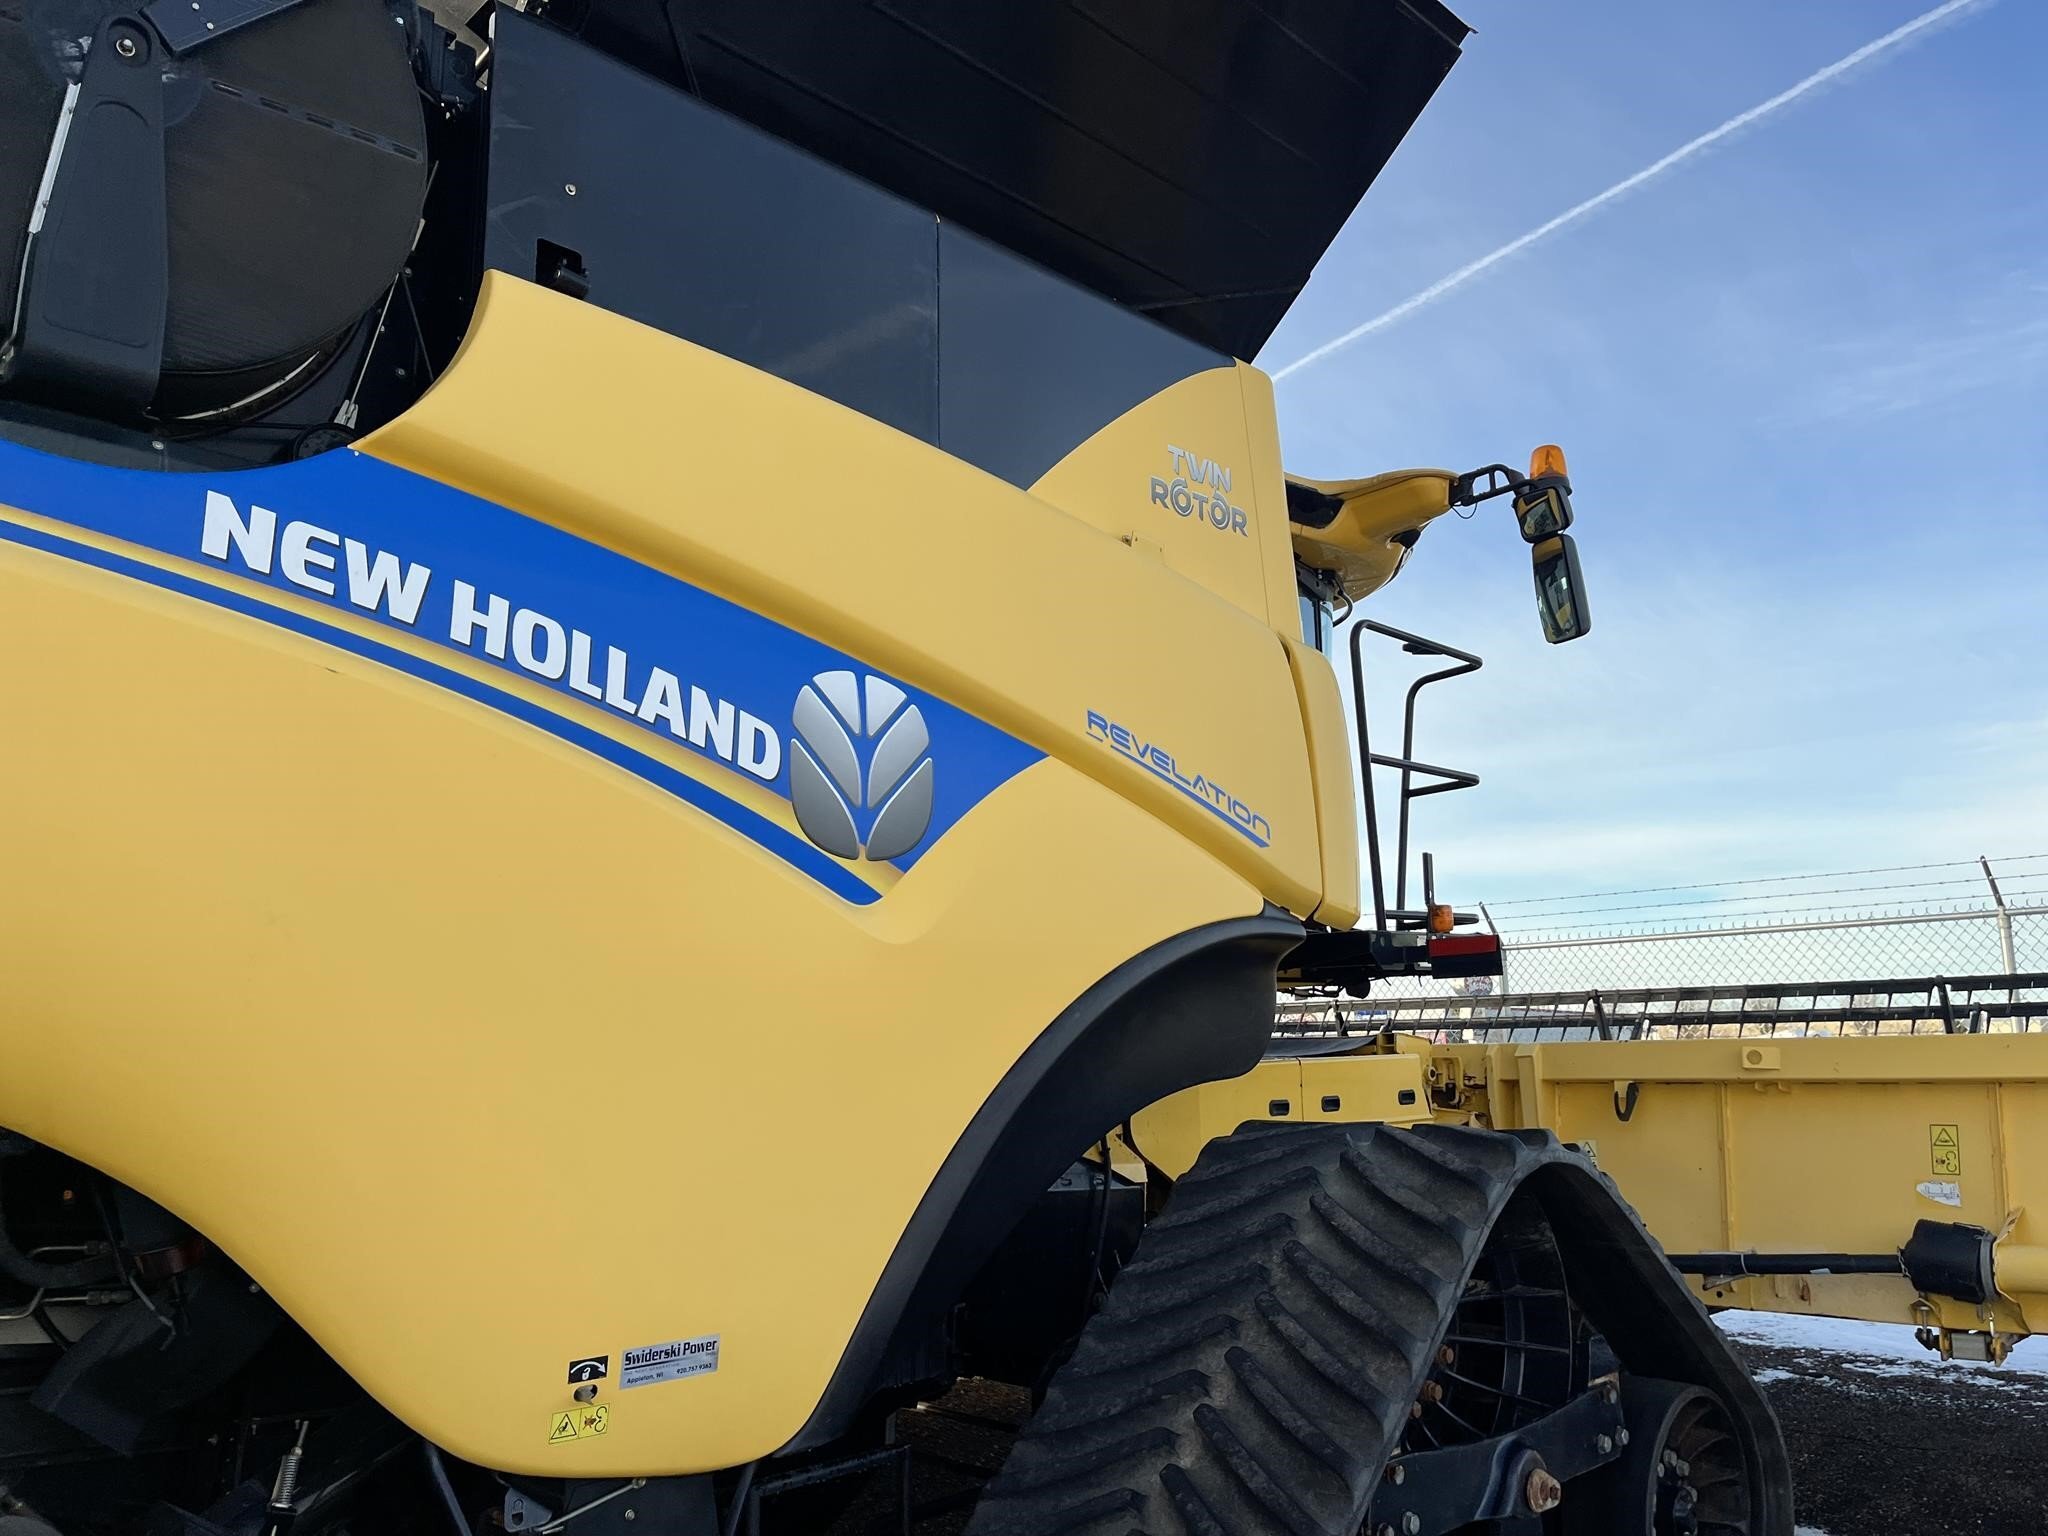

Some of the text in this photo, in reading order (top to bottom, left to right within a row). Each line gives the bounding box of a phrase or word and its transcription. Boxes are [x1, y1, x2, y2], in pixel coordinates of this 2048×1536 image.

[1167, 444, 1232, 493] TWIN
[1150, 476, 1248, 537] ROTOR
[201, 489, 782, 782] NEW HOLLAND
[1087, 709, 1271, 840] REVELATION
[624, 1340, 717, 1366] Swiderski Power
